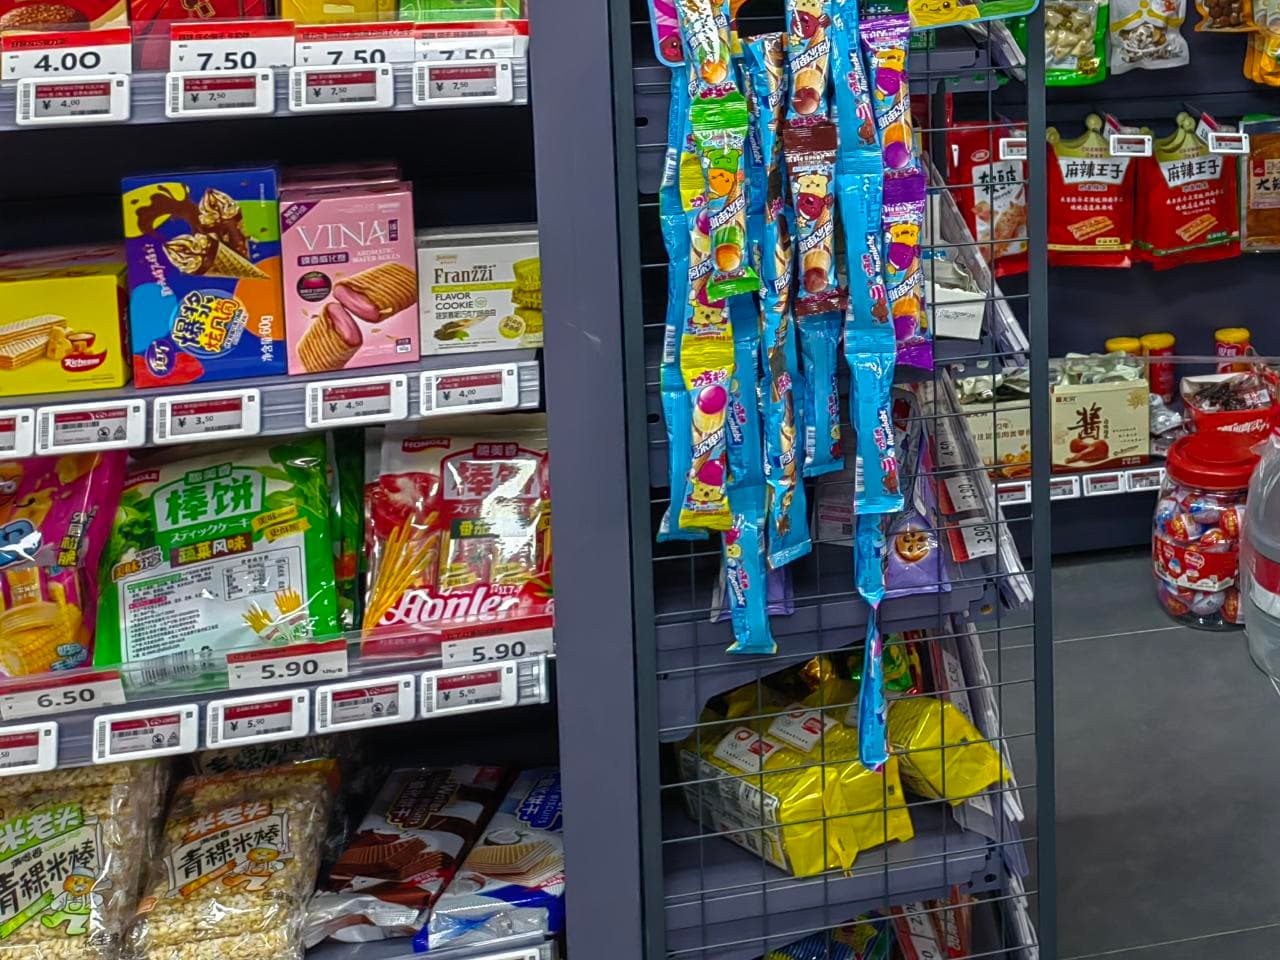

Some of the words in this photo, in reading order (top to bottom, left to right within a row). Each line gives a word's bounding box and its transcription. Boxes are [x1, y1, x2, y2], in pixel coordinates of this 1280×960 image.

[34, 51, 101, 72] 4.00
[197, 51, 257, 70] 7.50
[1065, 161, 1124, 179] 麻辣王子
[1167, 159, 1220, 182] 麻辣王子
[296, 219, 388, 251] VINA
[434, 266, 494, 284] Franzzi
[435, 292, 472, 300] FLAVOR
[435, 301, 474, 310] COOKIE
[165, 474, 254, 525] 棒饼
[169, 520, 250, 544] スティックケーキ
[178, 534, 248, 563] 蔬菜风味
[472, 641, 526, 662] 5.90
[261, 659, 319, 680] 5.90
[37, 688, 95, 708] 6.50
[0, 807, 82, 850] 米老头
[191, 803, 269, 835] 米老头
[177, 823, 282, 879] 青稞米棒
